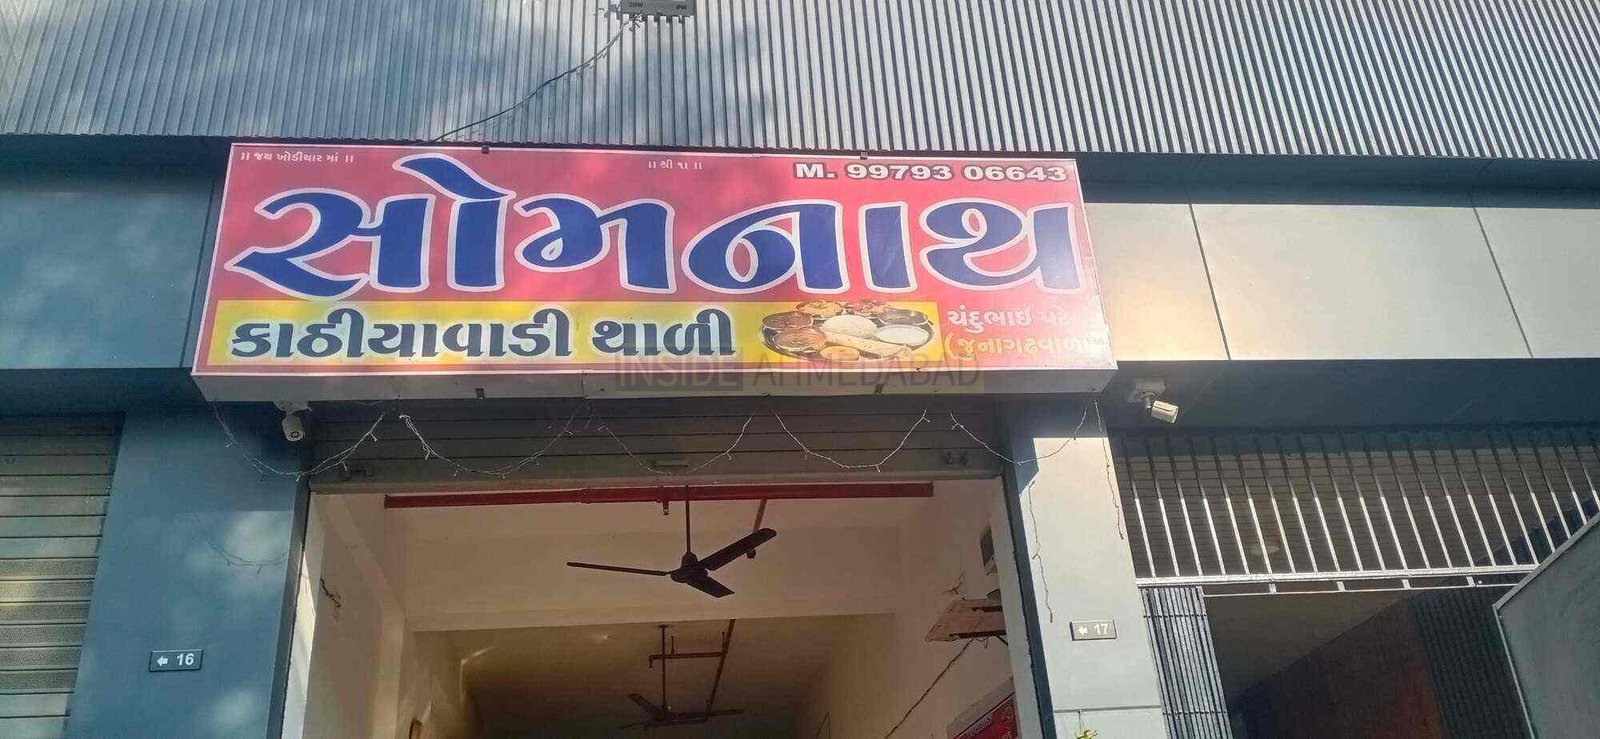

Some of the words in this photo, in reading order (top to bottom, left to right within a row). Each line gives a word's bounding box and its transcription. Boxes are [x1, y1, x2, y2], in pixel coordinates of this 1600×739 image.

[253, 152, 273, 161] જય
[326, 152, 340, 162] માં
[794, 161, 836, 179] M.
[846, 162, 953, 180] 99793
[963, 164, 1069, 182] 06643
[225, 152, 1087, 299] સોમનાથ
[230, 306, 574, 359] કાઠીયાવાડી
[591, 307, 736, 357] થાળી
[1094, 623, 1109, 635] 17
[177, 653, 194, 666] 16
